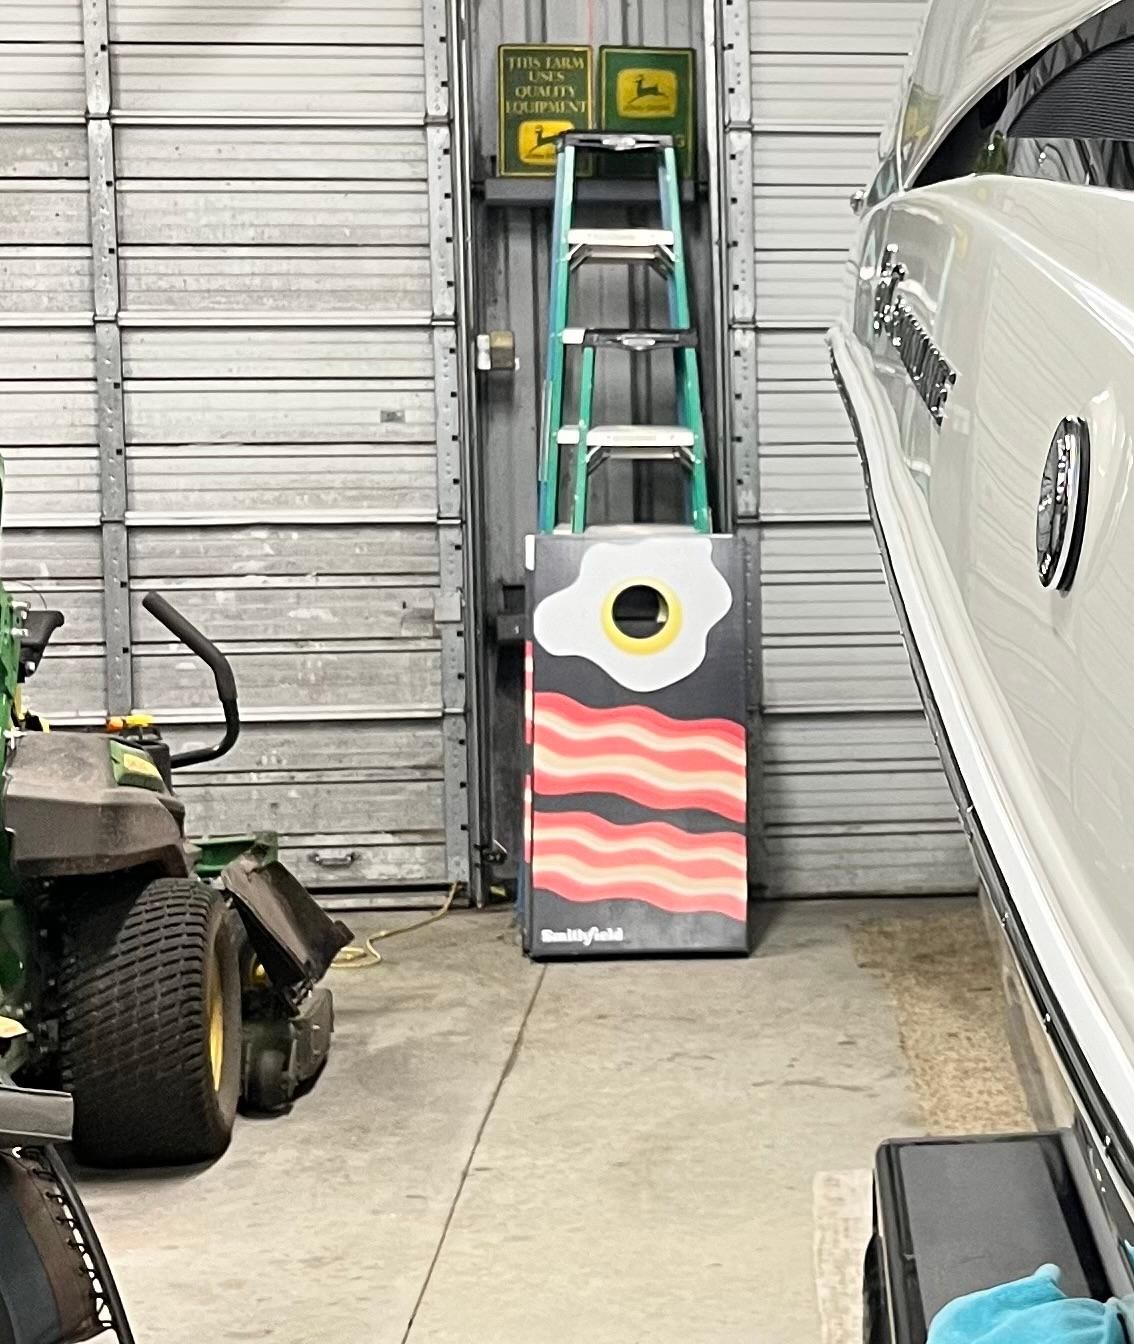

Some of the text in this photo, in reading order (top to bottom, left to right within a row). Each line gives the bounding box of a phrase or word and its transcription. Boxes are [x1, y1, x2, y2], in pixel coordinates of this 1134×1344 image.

[506, 56, 584, 70] THIS FARM
[529, 70, 565, 82] USES
[515, 85, 575, 98] QUALITY
[506, 100, 586, 114] EQUIPMENT
